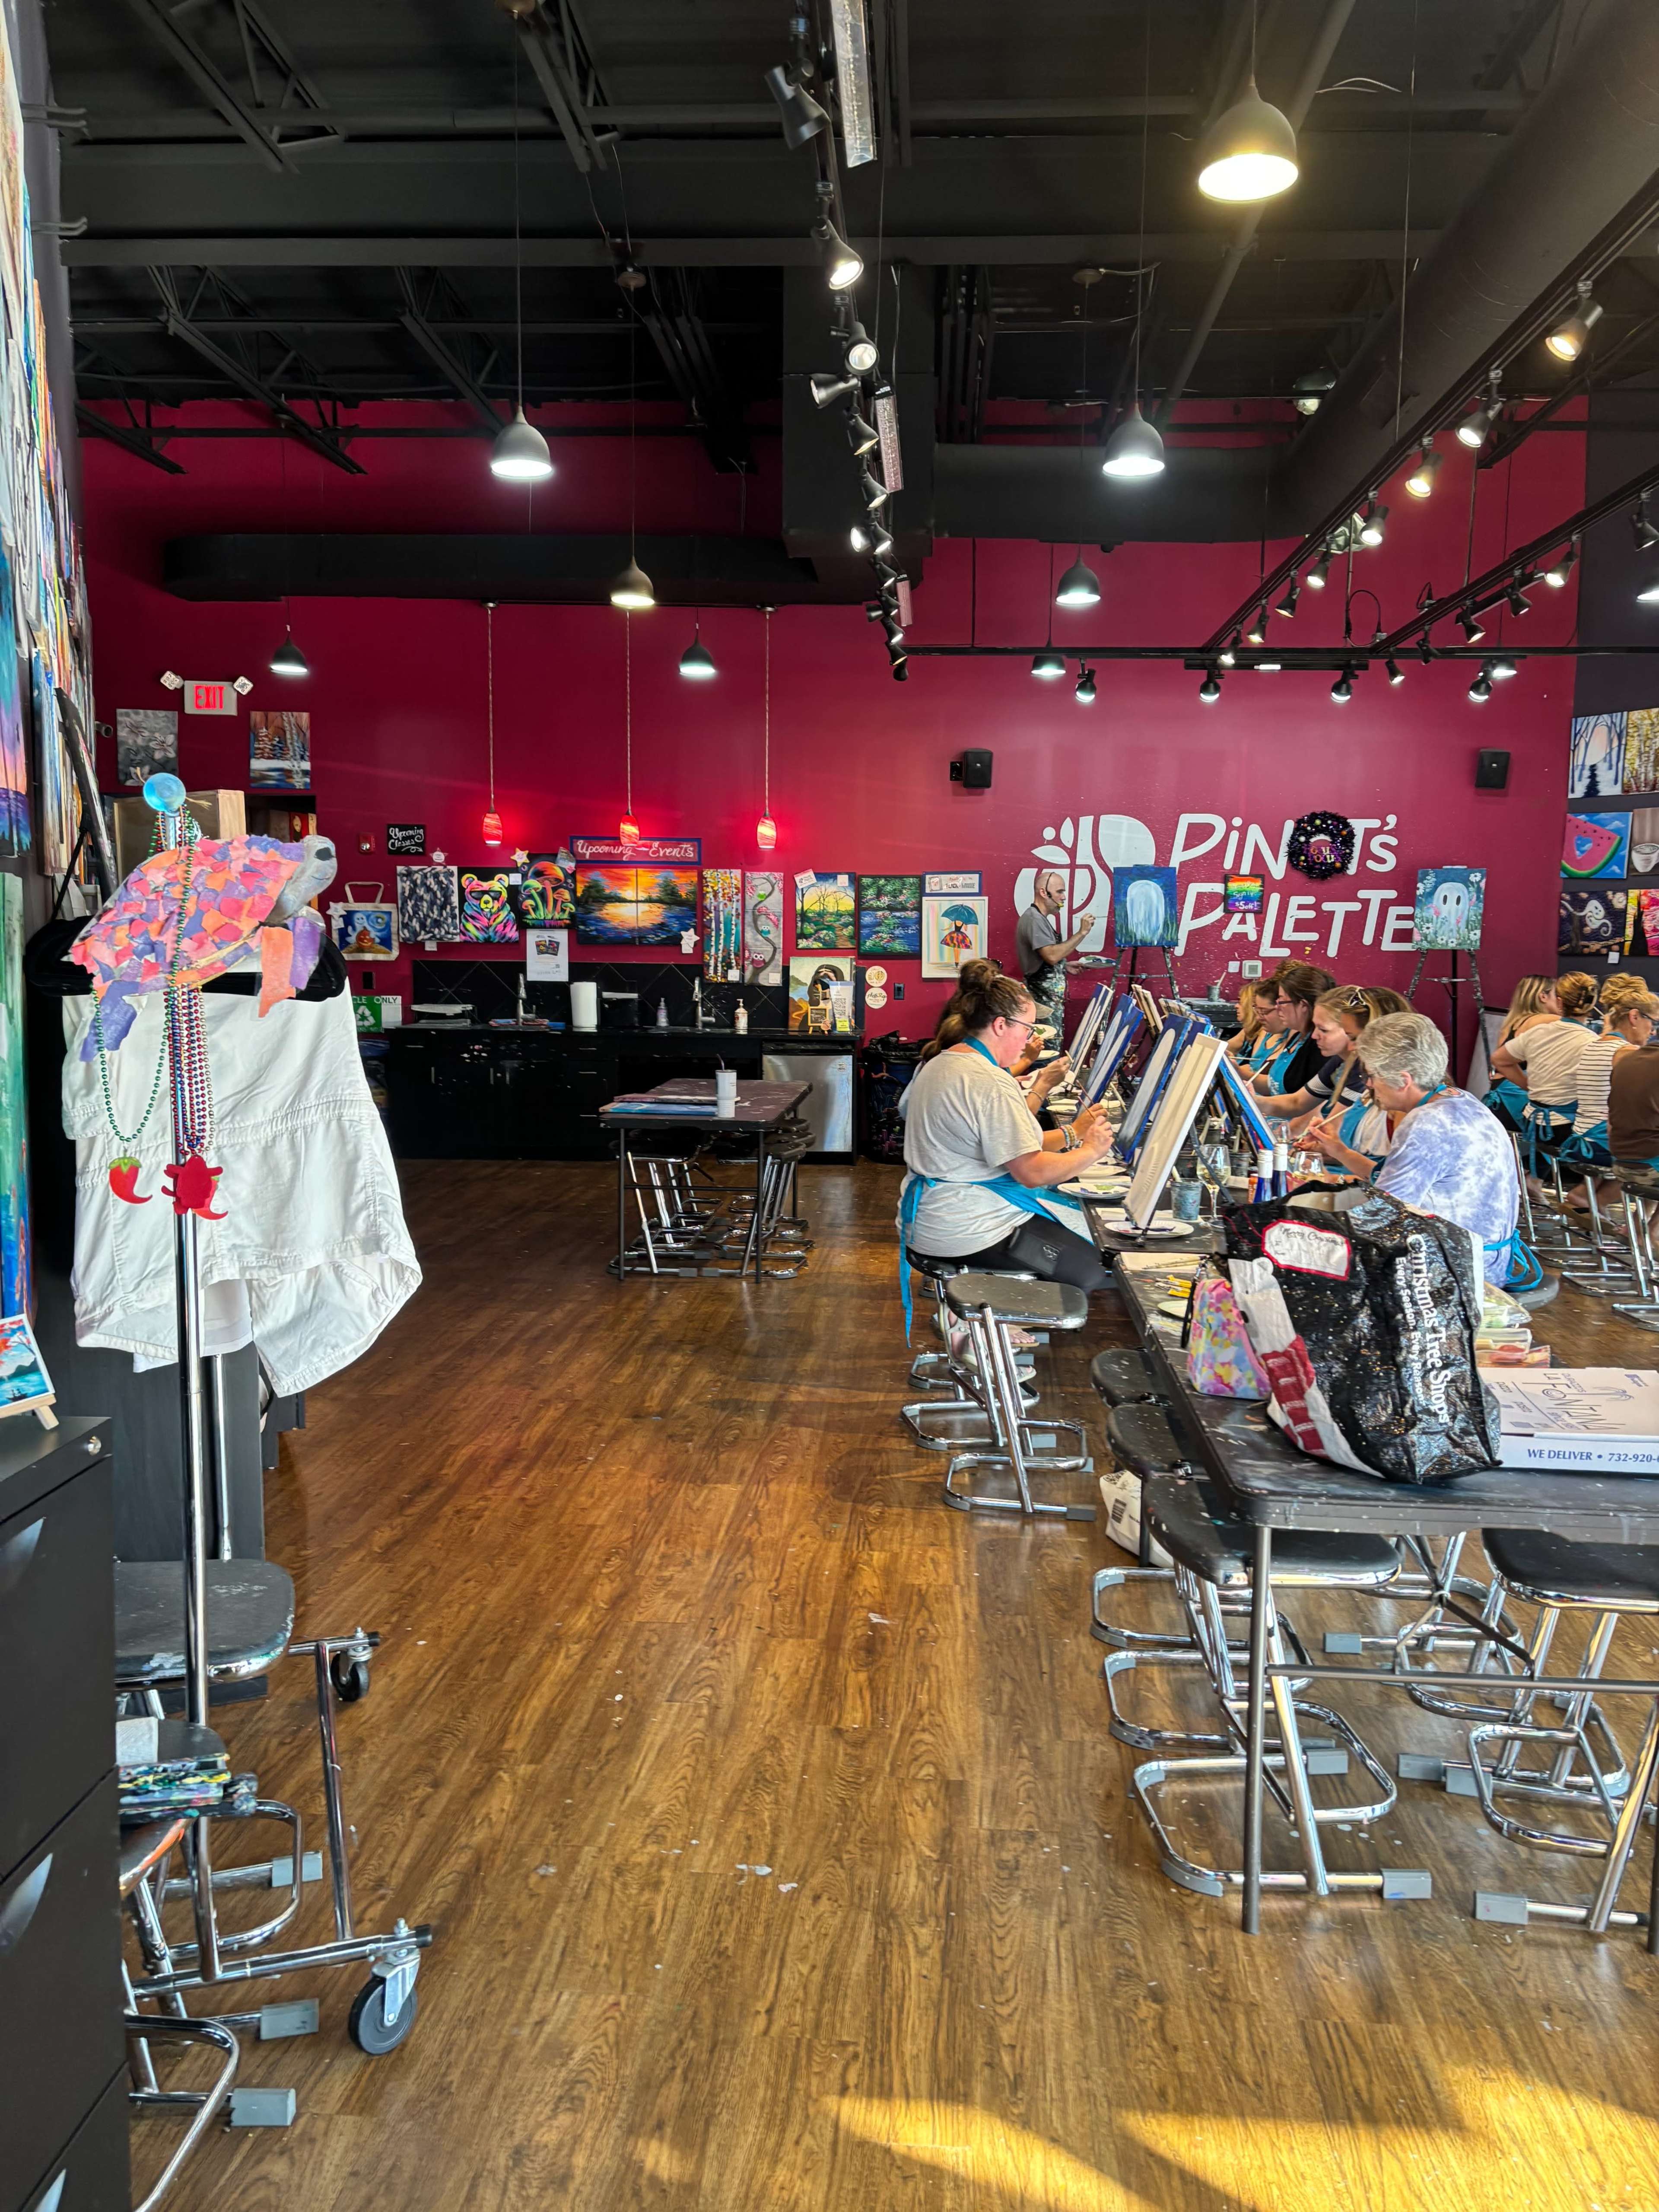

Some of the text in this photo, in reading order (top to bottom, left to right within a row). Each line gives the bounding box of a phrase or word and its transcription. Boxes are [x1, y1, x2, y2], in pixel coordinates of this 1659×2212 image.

[194, 685, 225, 710] EXIT
[389, 827, 424, 842] Upcoming
[577, 840, 694, 860] Upcoming Events
[1395, 1257, 1407, 1290] Every
[1409, 1331, 1422, 1362] Every
[1426, 1327, 1446, 1369] Tree
[1522, 1382, 1627, 1430] FONTANA
[1528, 1449, 1545, 1458] WE
[1548, 1450, 1592, 1461] DELIVER
